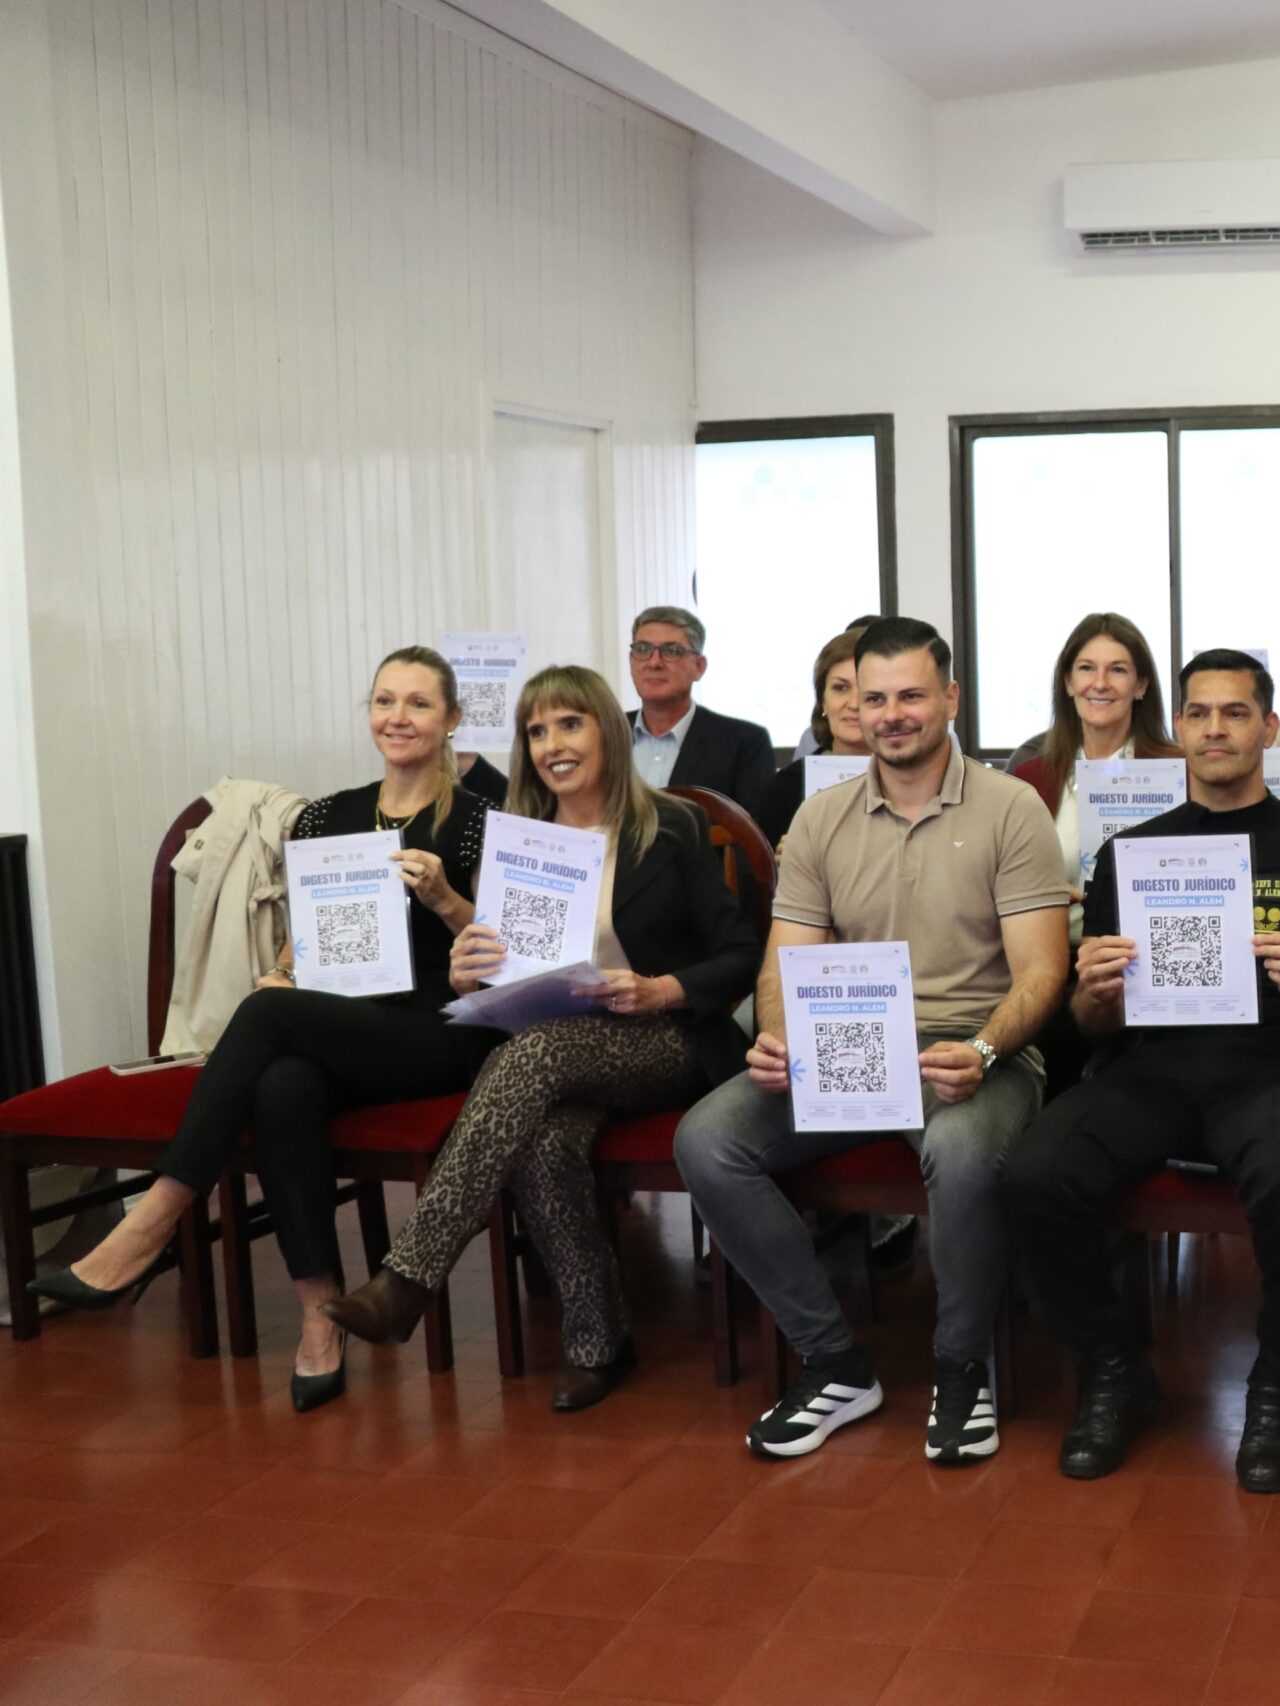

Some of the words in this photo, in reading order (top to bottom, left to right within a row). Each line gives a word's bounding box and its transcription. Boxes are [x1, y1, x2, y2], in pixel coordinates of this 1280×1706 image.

[1089, 793, 1128, 804] DIGESTO
[496, 850, 539, 870] DIGESTO
[542, 860, 588, 881] JURÍDICO
[300, 872, 341, 887] DIGESTO
[1132, 878, 1180, 892] DIGESTO
[1184, 876, 1236, 892] JURÍDICO
[1146, 897, 1187, 906] LEANDRO
[1199, 896, 1223, 905] ALEM
[797, 985, 843, 999] DIGESTO
[847, 982, 897, 998] JURÍDICO
[811, 1004, 850, 1013] LEANDRO
[862, 1003, 885, 1012] ALEM
